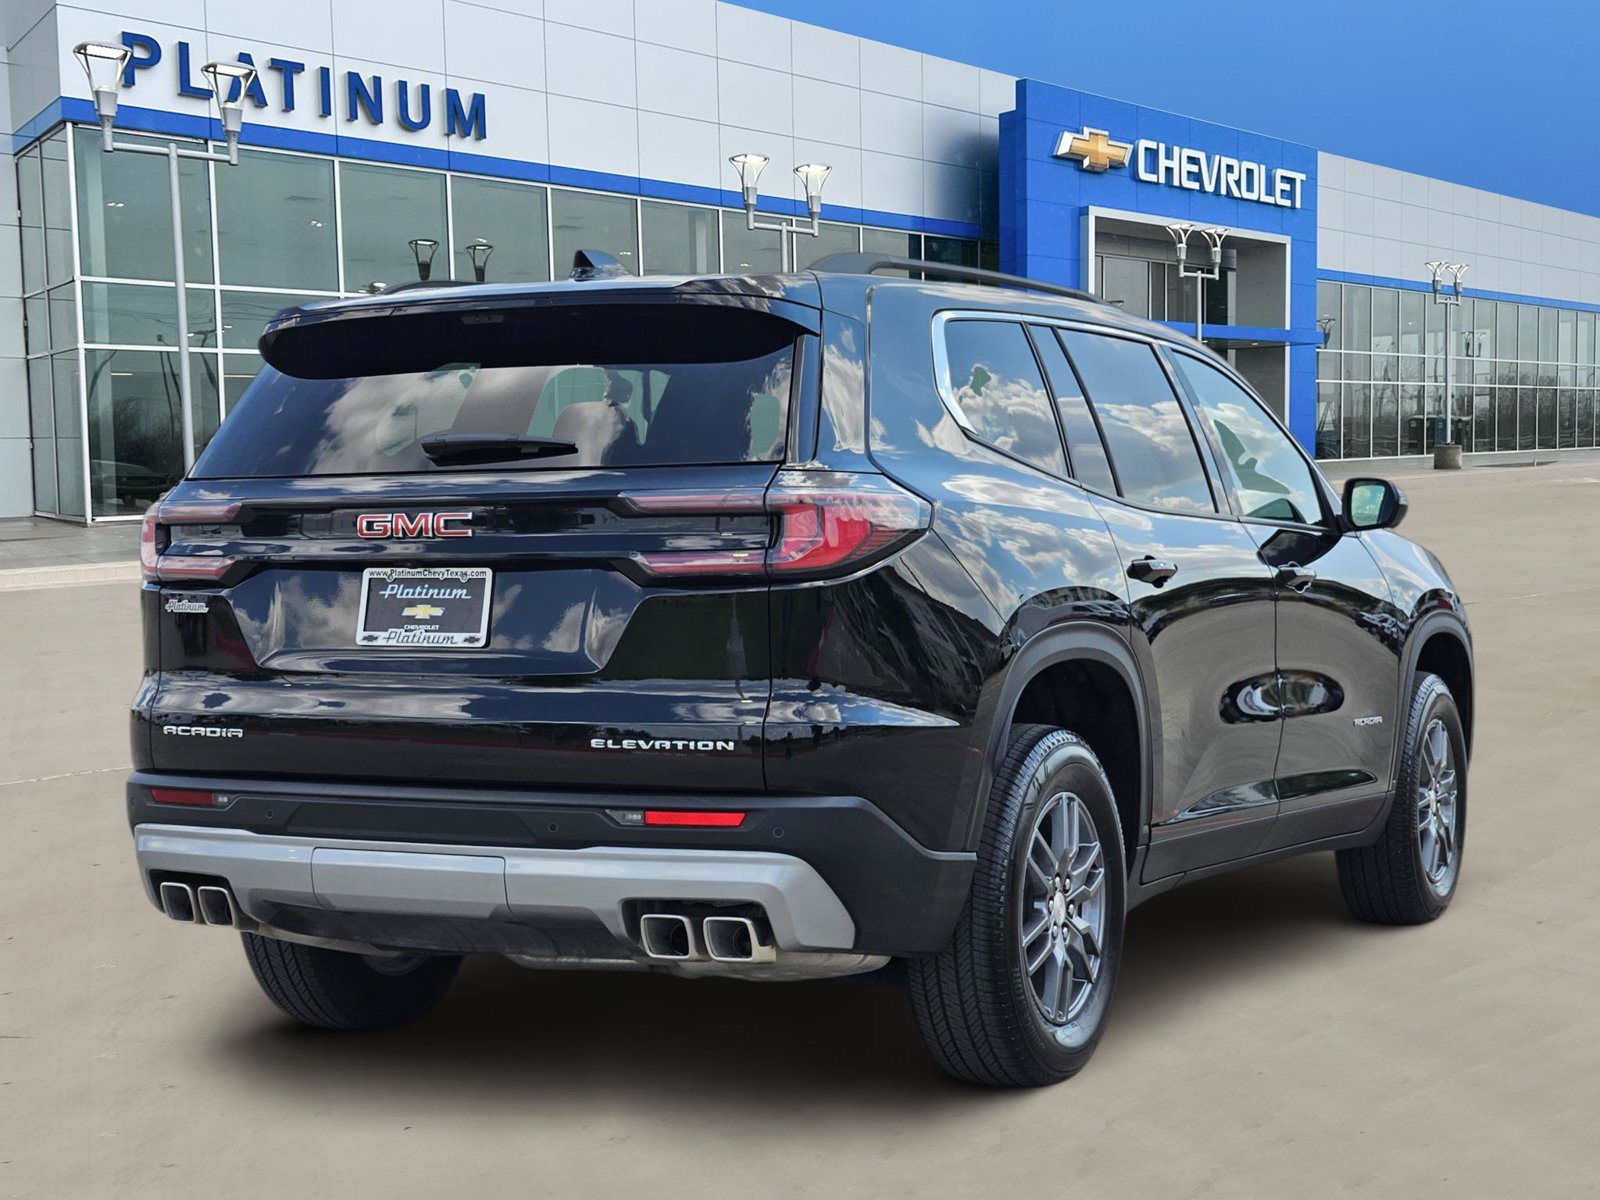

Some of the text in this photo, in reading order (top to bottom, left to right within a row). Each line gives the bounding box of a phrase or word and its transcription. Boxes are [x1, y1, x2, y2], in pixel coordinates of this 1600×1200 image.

[121, 31, 486, 141] PLATINUM
[1136, 138, 1307, 209] CHEVROLET
[357, 512, 473, 538] GMC
[379, 584, 472, 599] Platinum
[382, 629, 458, 645] Platinum
[163, 725, 244, 738] ACADIA
[590, 738, 735, 751] ELEVATION
